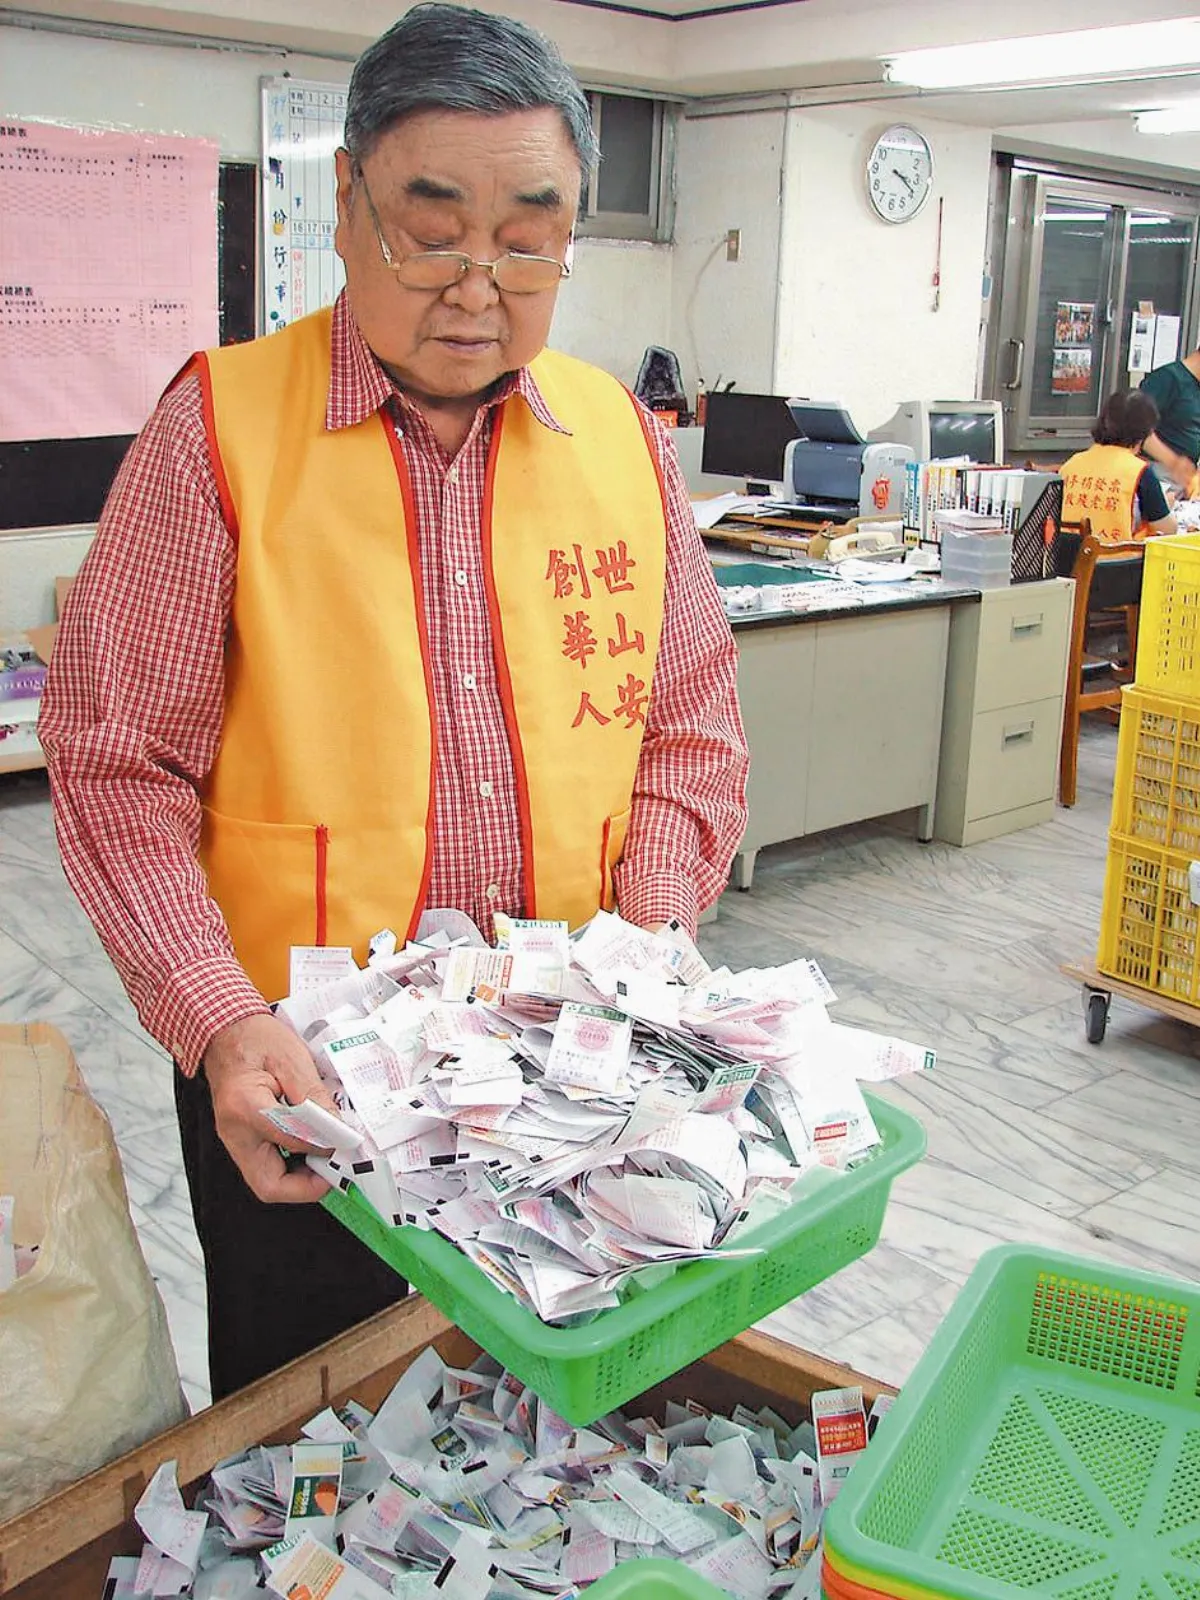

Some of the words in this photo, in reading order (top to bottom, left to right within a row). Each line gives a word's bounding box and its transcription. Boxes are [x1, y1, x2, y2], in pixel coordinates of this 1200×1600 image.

[323, 94, 329, 104] 2
[872, 162, 879, 174] 9
[913, 158, 920, 170] 2
[873, 179, 880, 191] 8
[913, 173, 920, 185] 3
[880, 190, 886, 202] 7
[888, 199, 895, 210] 6
[899, 197, 906, 208] 5
[293, 222, 303, 233] 16
[307, 223, 317, 233] 17
[545, 540, 636, 600] 創世
[561, 610, 645, 670] 華山
[571, 673, 649, 729] 人安
